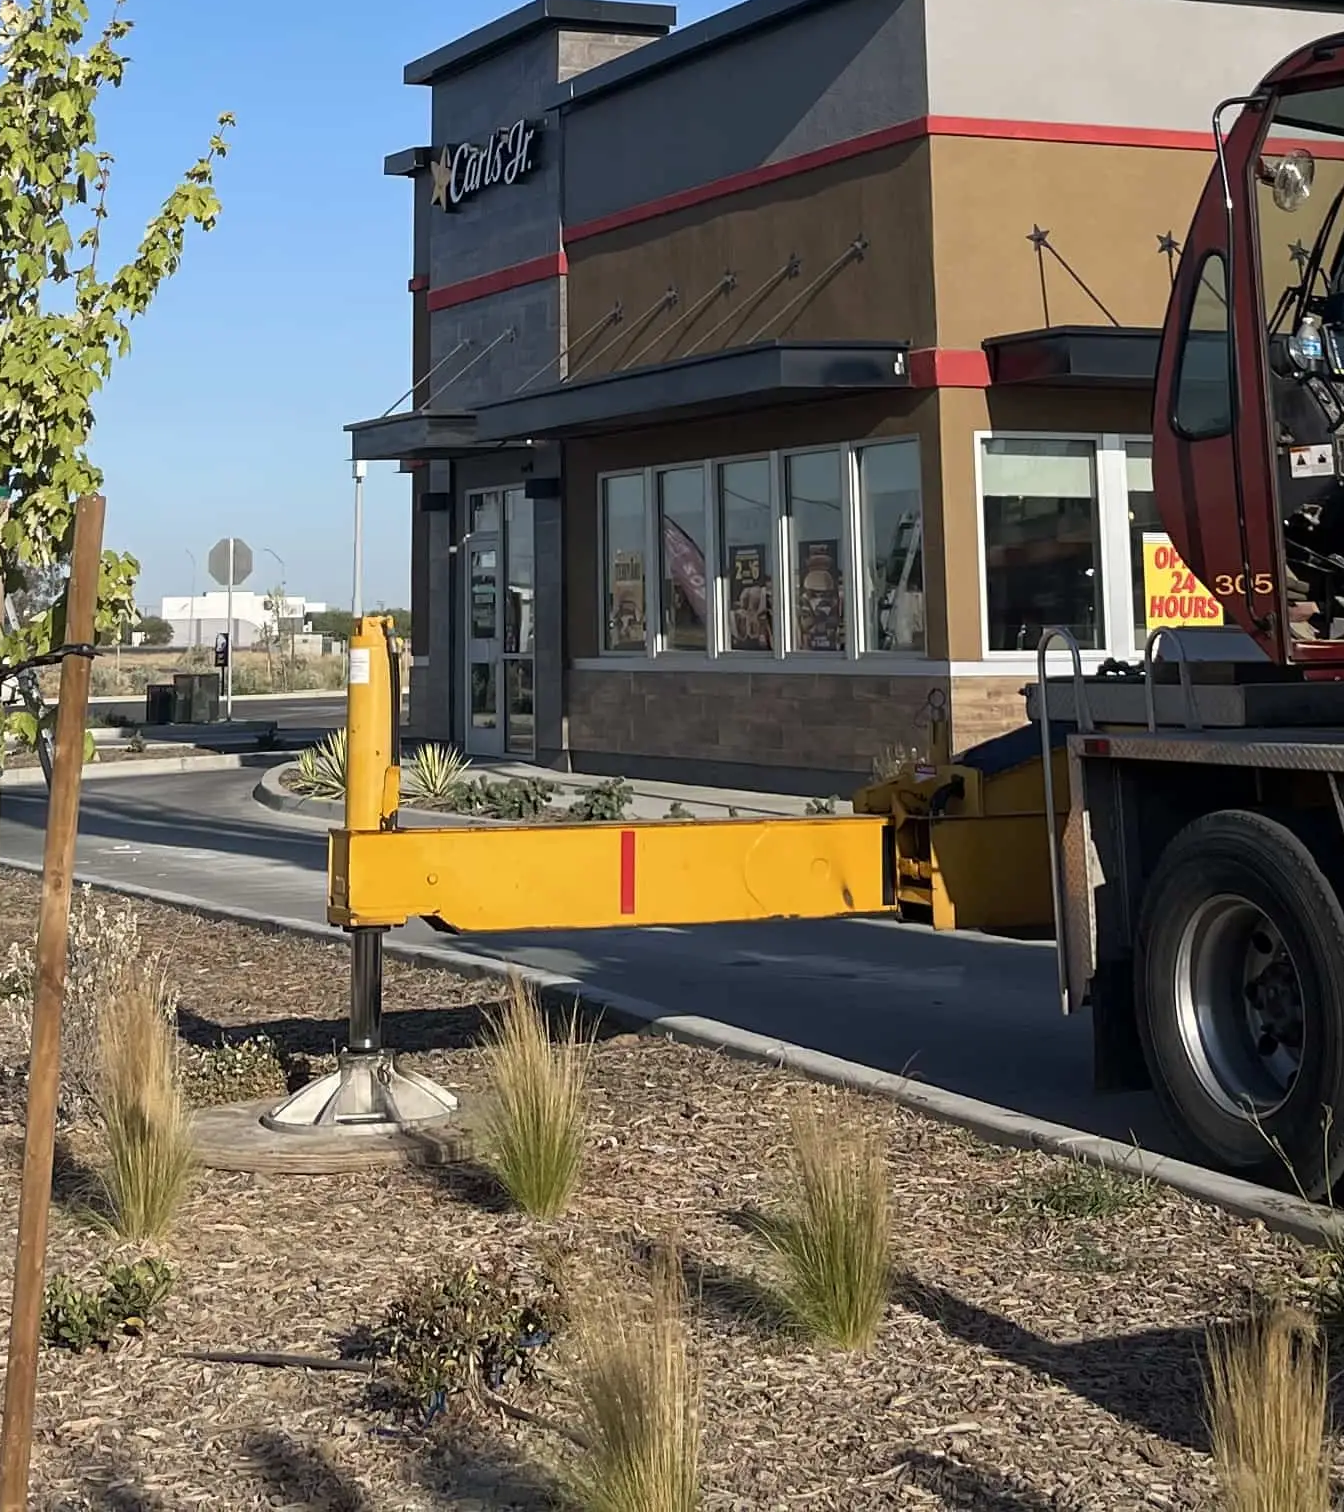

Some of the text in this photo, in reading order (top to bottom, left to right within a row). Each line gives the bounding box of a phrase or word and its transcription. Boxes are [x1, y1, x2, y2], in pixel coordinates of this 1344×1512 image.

[504, 119, 535, 185] Jr.
[1171, 571, 1197, 594] 24
[1215, 573, 1274, 595] 305
[1149, 594, 1219, 619] HOURS
